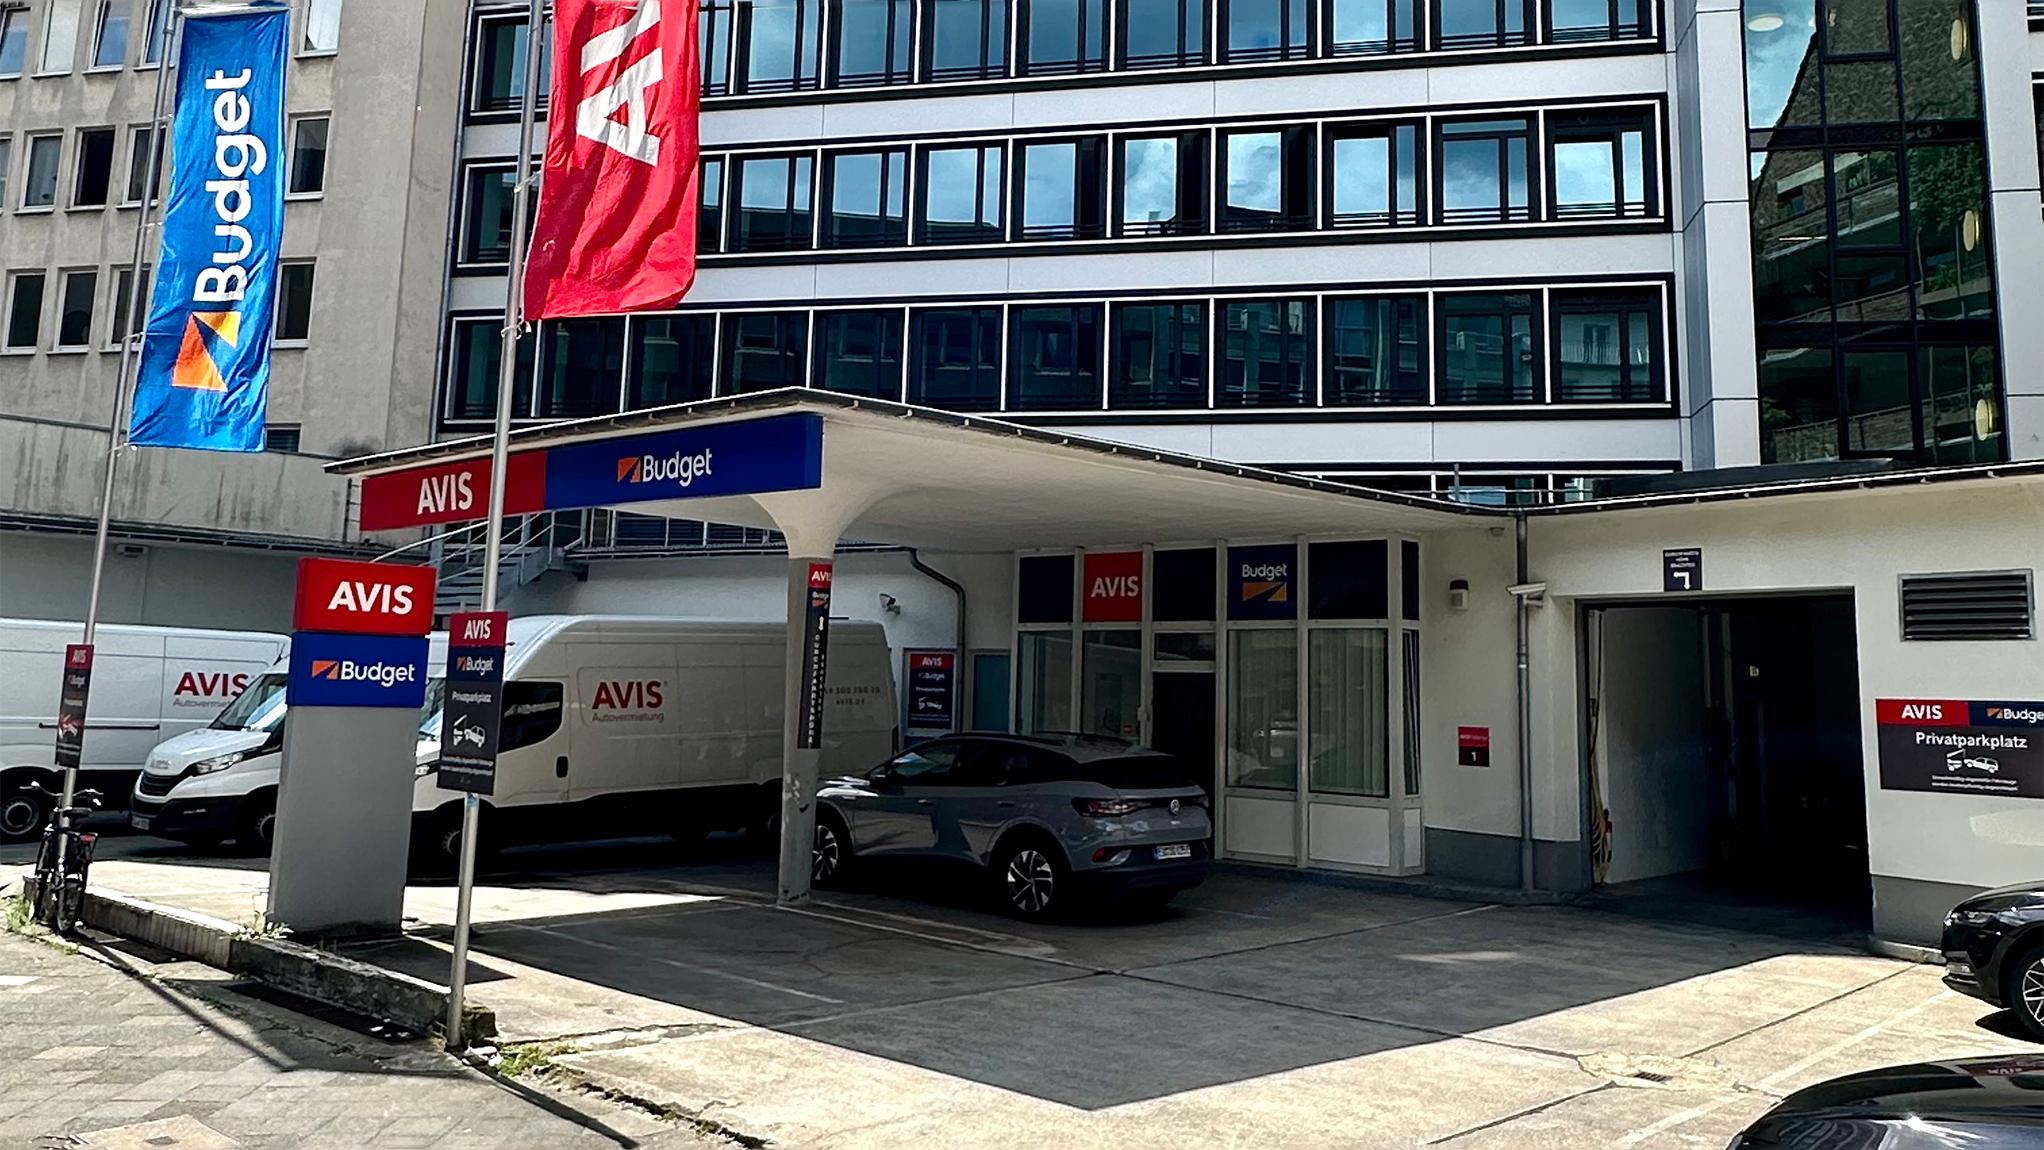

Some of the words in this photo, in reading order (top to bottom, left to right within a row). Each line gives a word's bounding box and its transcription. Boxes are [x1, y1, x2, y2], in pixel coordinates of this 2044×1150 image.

[192, 68, 267, 302] Budget
[642, 448, 713, 487] Budget
[416, 471, 473, 516] AVIS
[1242, 563, 1288, 581] Budget
[327, 580, 414, 615] AVIS
[1091, 576, 1139, 598] AVIS
[463, 619, 491, 640] AVIS
[466, 656, 494, 676] Budget
[922, 657, 942, 666] AVIS
[174, 672, 249, 697] AVIS
[340, 661, 415, 687] Budget
[591, 681, 663, 709] AVIS
[1901, 704, 1942, 720] AVIS
[1915, 731, 2028, 750] Privatparkplatz
[1471, 751, 1477, 762] 1
